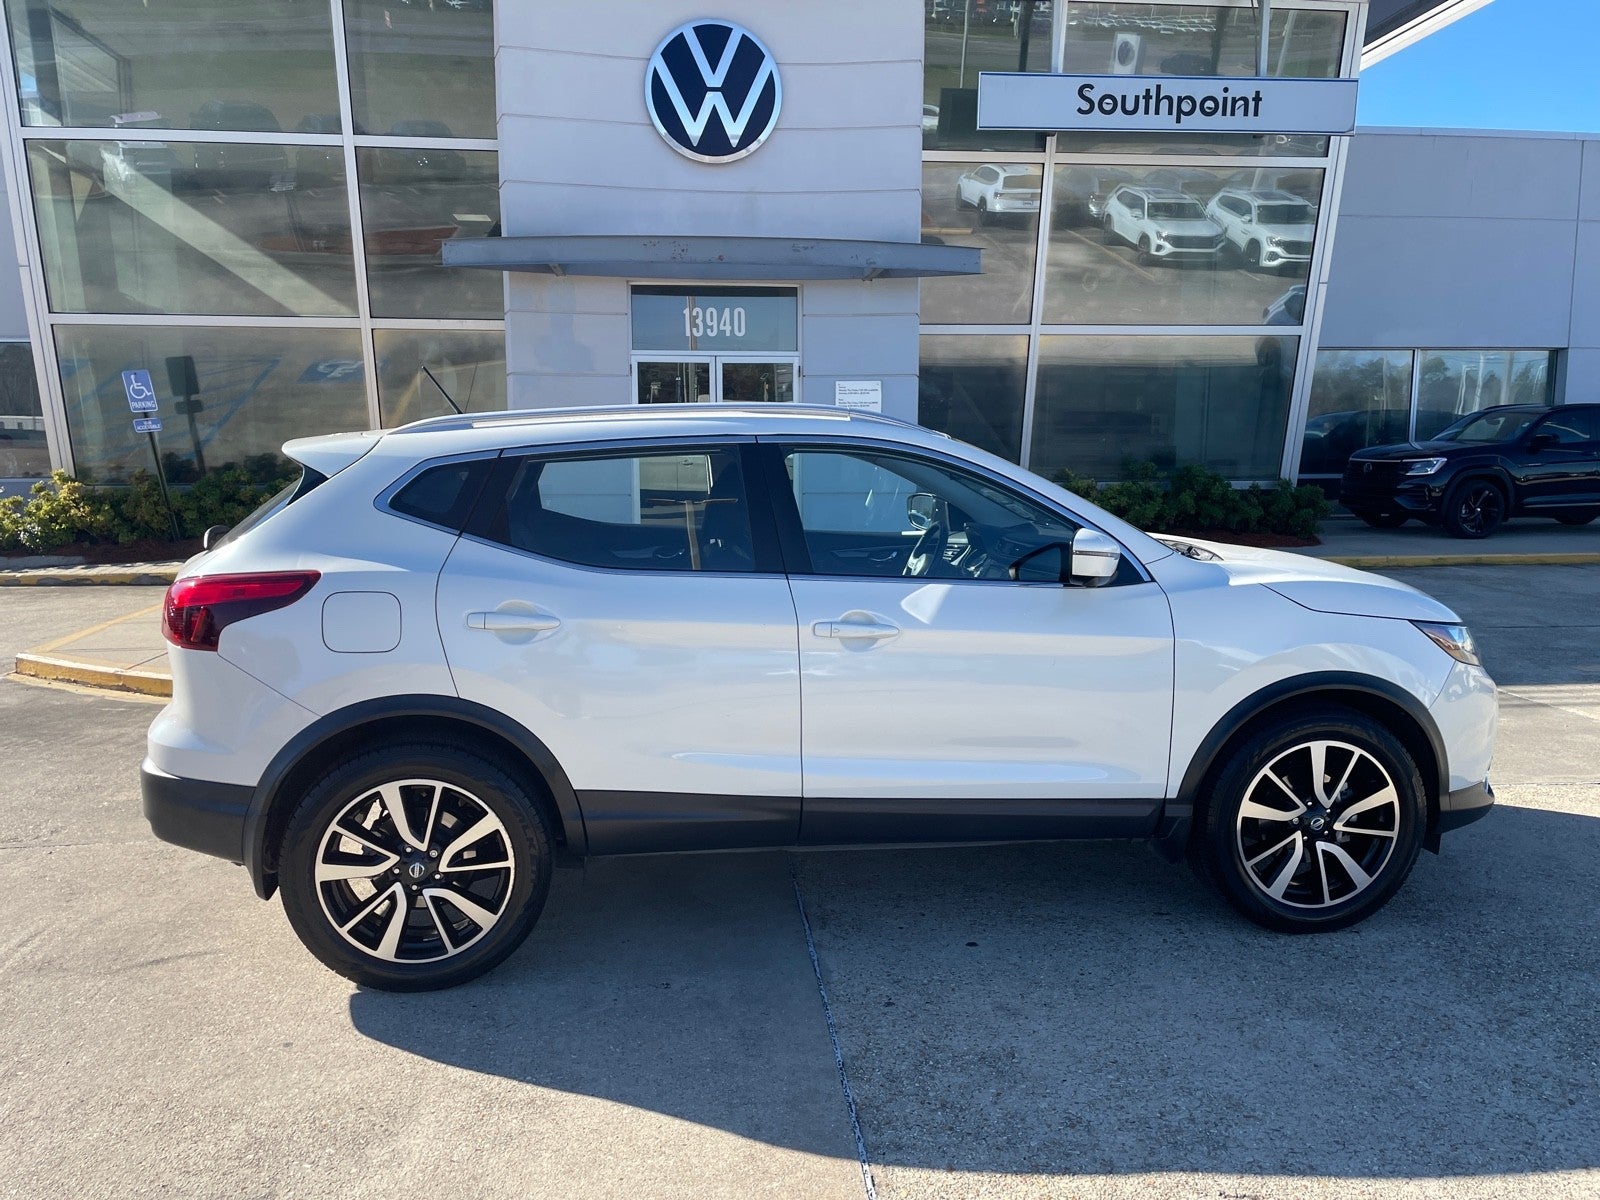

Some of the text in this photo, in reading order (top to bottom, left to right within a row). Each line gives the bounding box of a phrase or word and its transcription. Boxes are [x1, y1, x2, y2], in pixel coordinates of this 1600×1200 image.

[1076, 83, 1263, 124] Southpoint
[683, 307, 746, 337] 13940
[131, 401, 156, 409] PARKING
